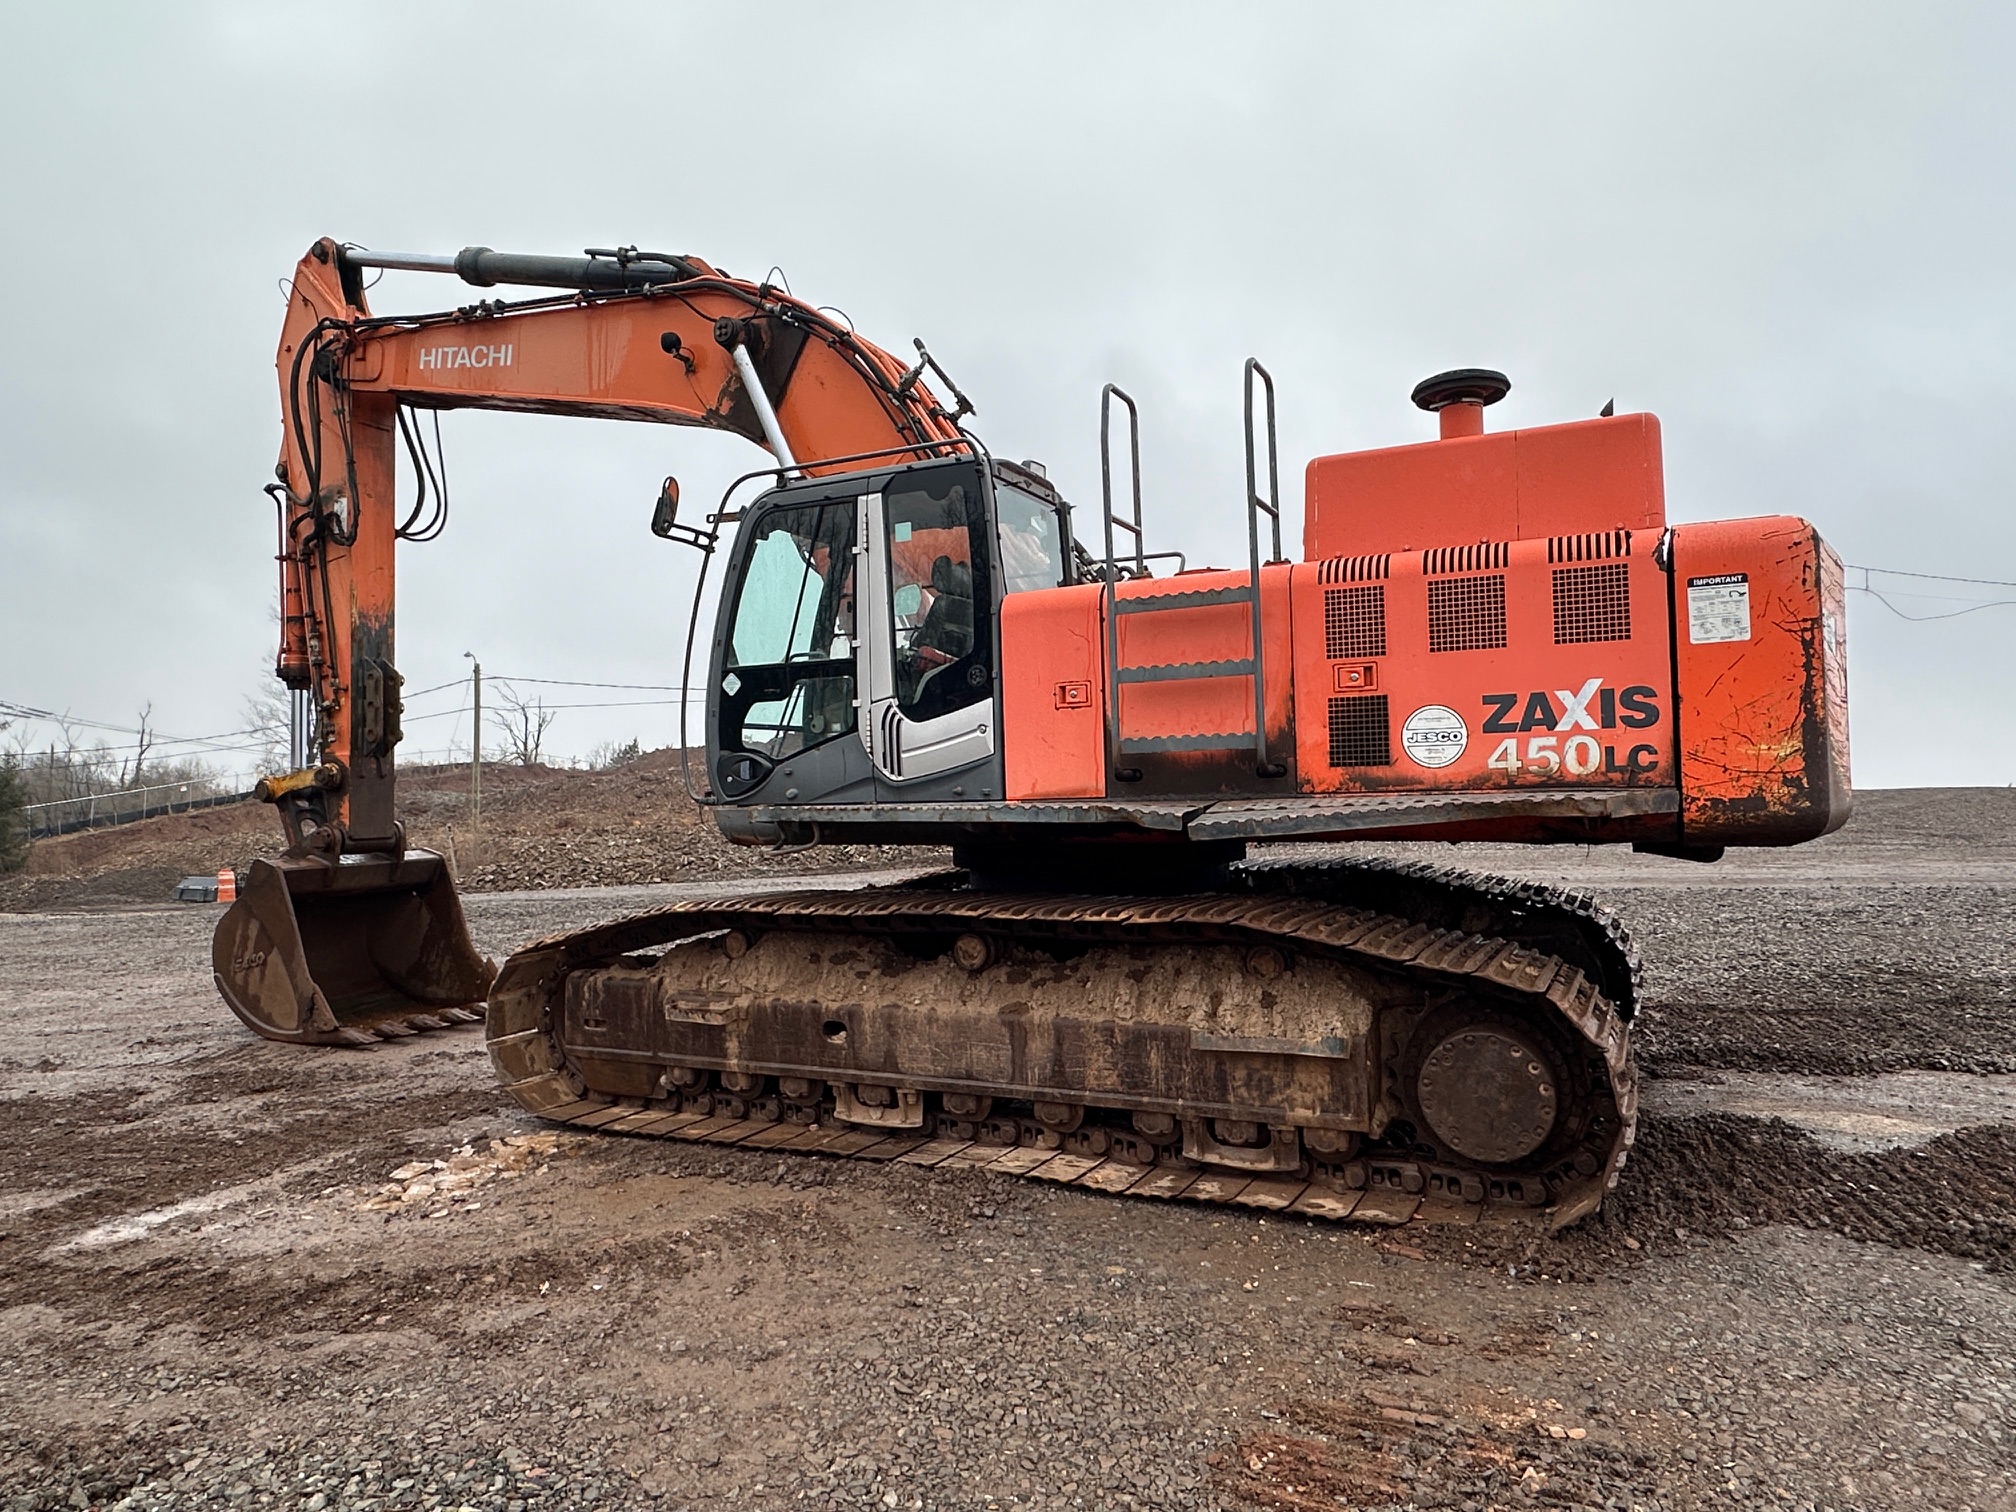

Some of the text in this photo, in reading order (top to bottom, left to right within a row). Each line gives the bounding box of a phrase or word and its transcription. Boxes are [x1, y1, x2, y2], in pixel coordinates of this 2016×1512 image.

[419, 344, 513, 370] HITACHI
[1693, 575, 1743, 586] IMPORTANT
[1482, 678, 1660, 733] ZAXIS
[1407, 731, 1463, 744] JESCO
